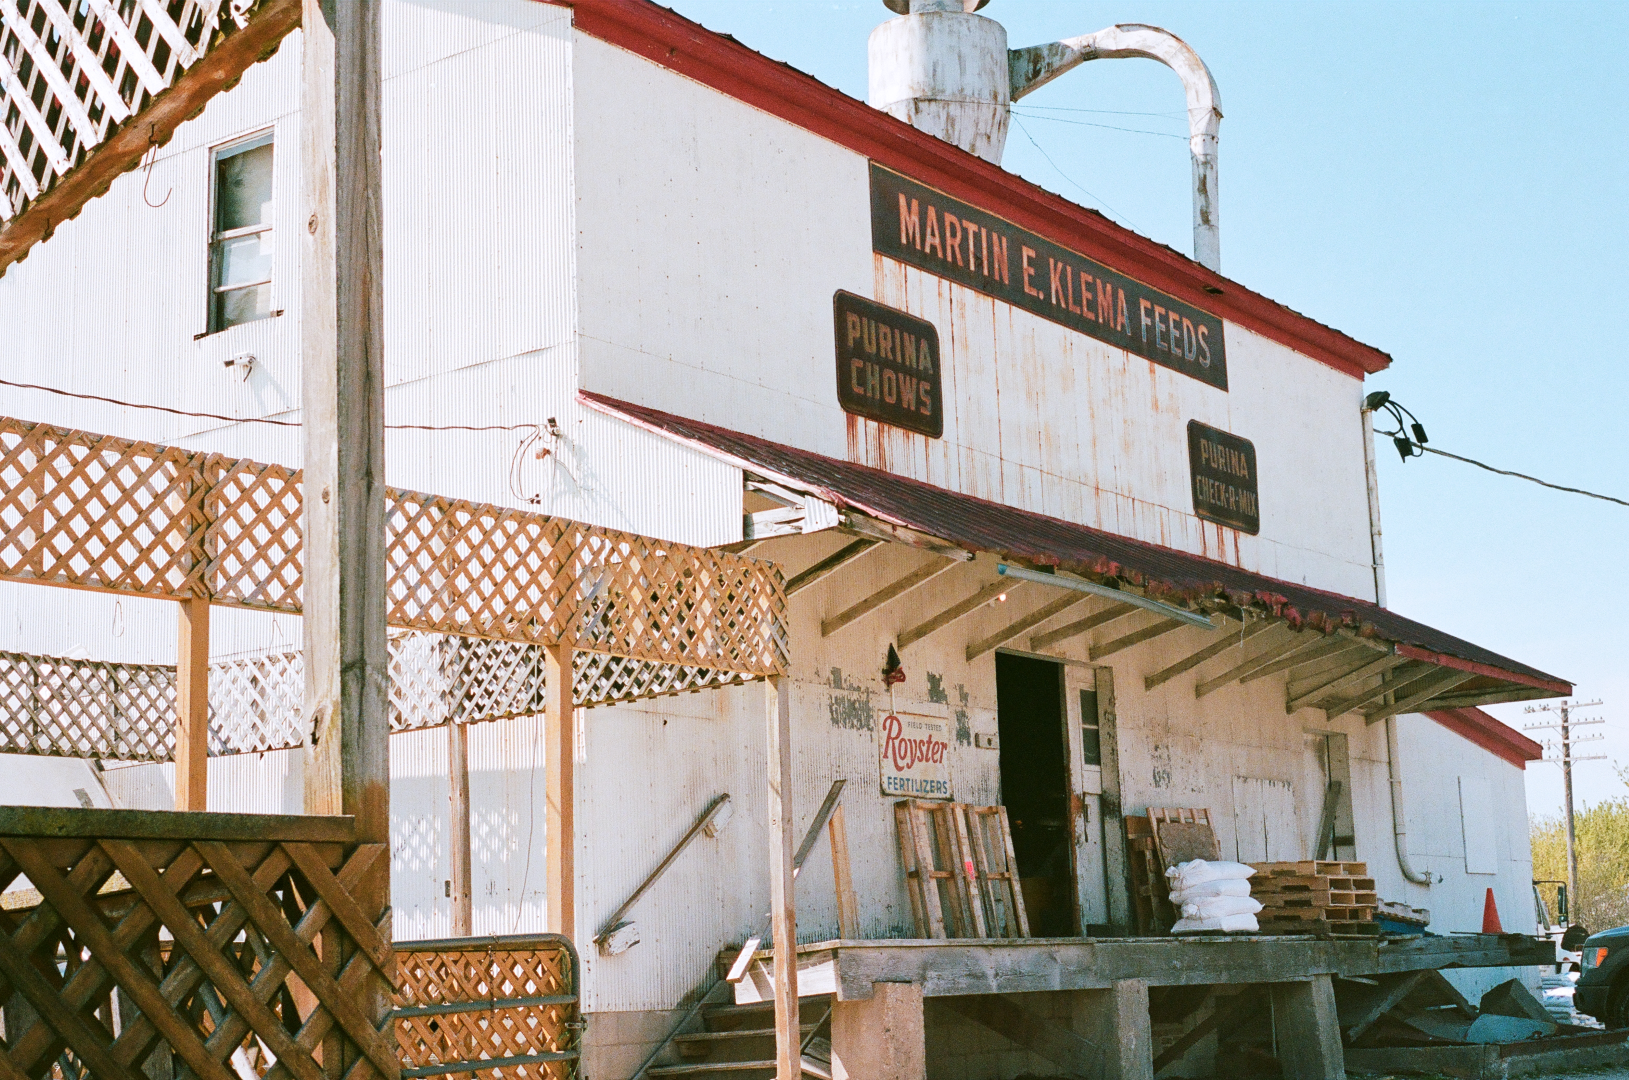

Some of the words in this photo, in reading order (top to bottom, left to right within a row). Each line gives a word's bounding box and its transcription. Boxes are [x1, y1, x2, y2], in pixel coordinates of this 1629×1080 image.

[898, 193, 1009, 286] MARTIN
[1021, 245, 1044, 300] E.
[1049, 260, 1131, 336] KLEMA
[1139, 299, 1211, 369] FEEDS
[846, 311, 933, 374] PURINA
[851, 358, 932, 416] CHOWS
[1201, 438, 1249, 479] PURINA
[1196, 475, 1257, 517] CHECK-R-MIX
[882, 716, 947, 772] Royster
[908, 721, 922, 730] FIELD
[925, 723, 942, 732] TESTED
[887, 776, 947, 794] FERTILIZERS
